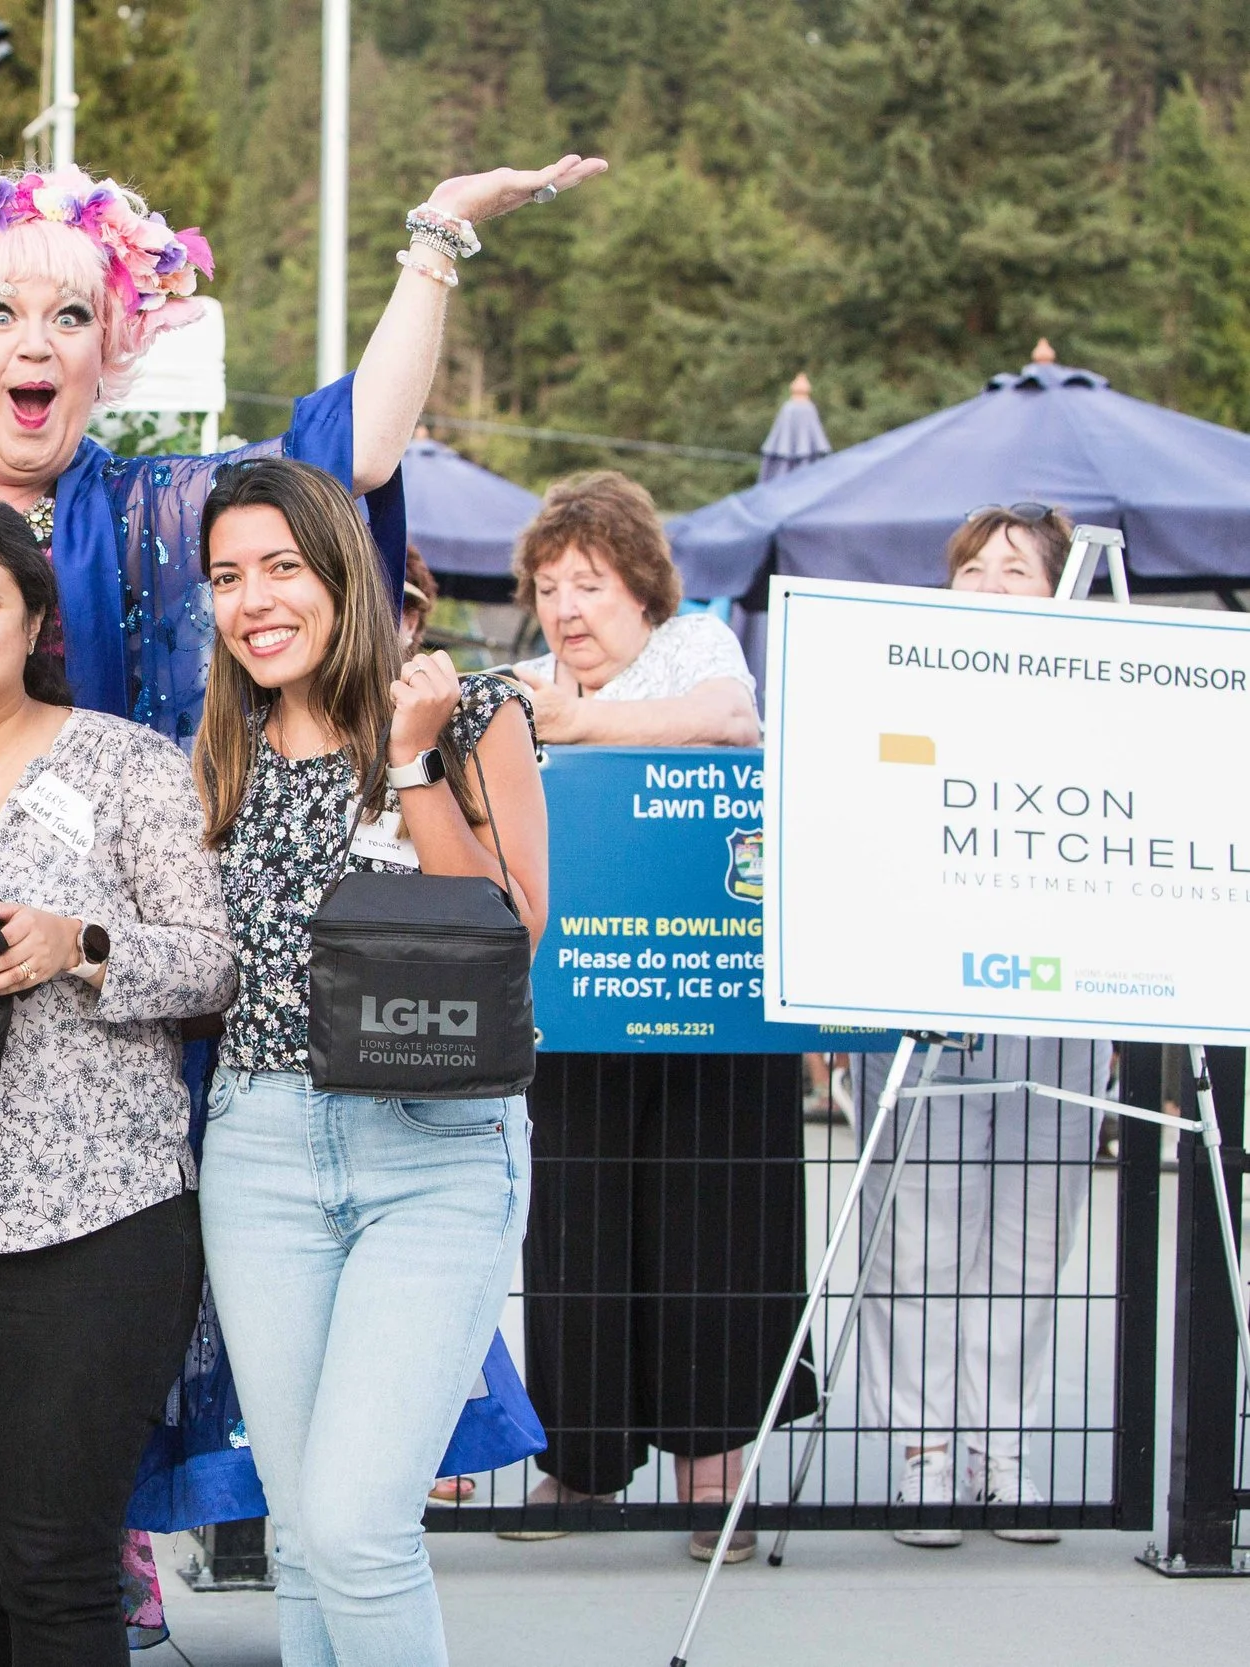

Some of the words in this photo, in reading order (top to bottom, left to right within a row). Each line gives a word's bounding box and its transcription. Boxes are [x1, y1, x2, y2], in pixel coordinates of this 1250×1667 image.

[888, 644, 1009, 674] BALLOON
[1018, 655, 1111, 681] RAFFLE
[1120, 662, 1246, 691] SPONSOR
[646, 764, 727, 790] North
[633, 795, 706, 819] Lawn
[943, 778, 1134, 820] DIXON
[943, 826, 1250, 873] MITCHELL
[942, 870, 1114, 894] INVESTMENT
[560, 917, 649, 937] WINTER
[655, 917, 763, 938] BOWLING
[558, 948, 631, 970] Please
[637, 947, 665, 970] do
[671, 951, 712, 970] not
[716, 951, 763, 971] ente
[963, 952, 1030, 989] LGH
[573, 975, 590, 998] if
[594, 977, 671, 1001] FROST,
[678, 978, 712, 998] ICE
[718, 982, 743, 998] or
[1075, 980, 1175, 997] FOUNDATION
[360, 995, 440, 1035] LGH
[626, 1022, 715, 1036] 604.985.2321
[360, 1039, 391, 1050] LIONS
[394, 1042, 422, 1051] GATE
[426, 1043, 476, 1053] HOSPITAL
[359, 1050, 476, 1067] FOUNDATION
